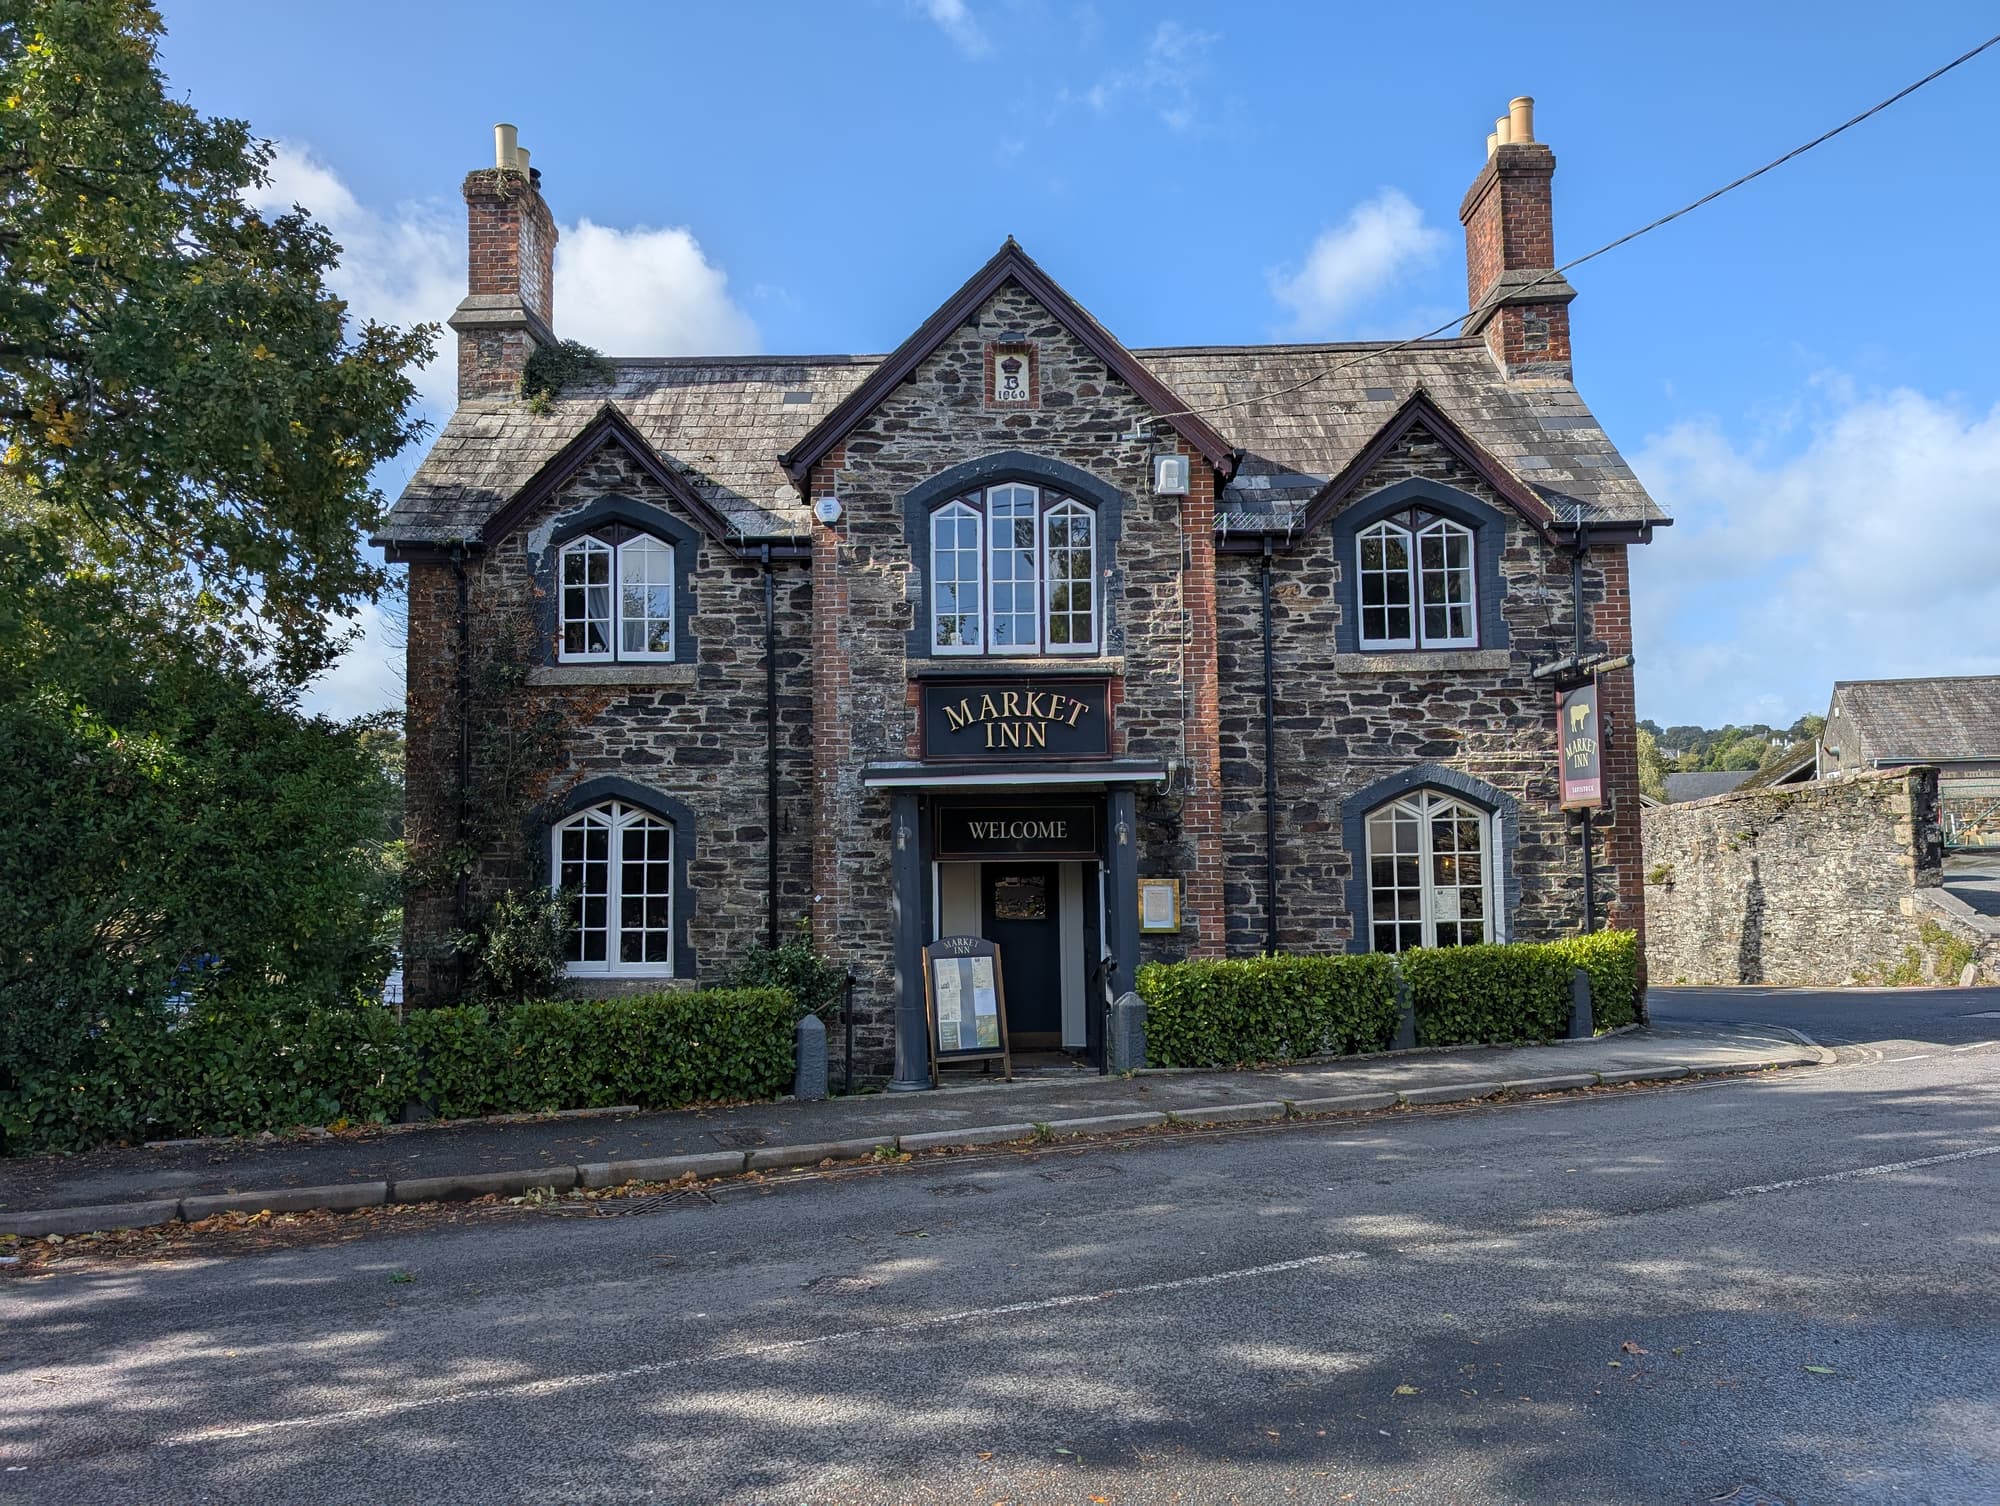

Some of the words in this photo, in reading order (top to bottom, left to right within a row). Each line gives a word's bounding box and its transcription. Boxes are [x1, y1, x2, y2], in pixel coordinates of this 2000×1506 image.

[942, 691, 1090, 732] MARKET
[984, 721, 1047, 748] INN
[1565, 737, 1597, 760] MARKET
[1574, 753, 1589, 769] INN
[968, 821, 1067, 839] WELCOME
[943, 938, 978, 950] MARKET
[954, 945, 970, 954] INN
